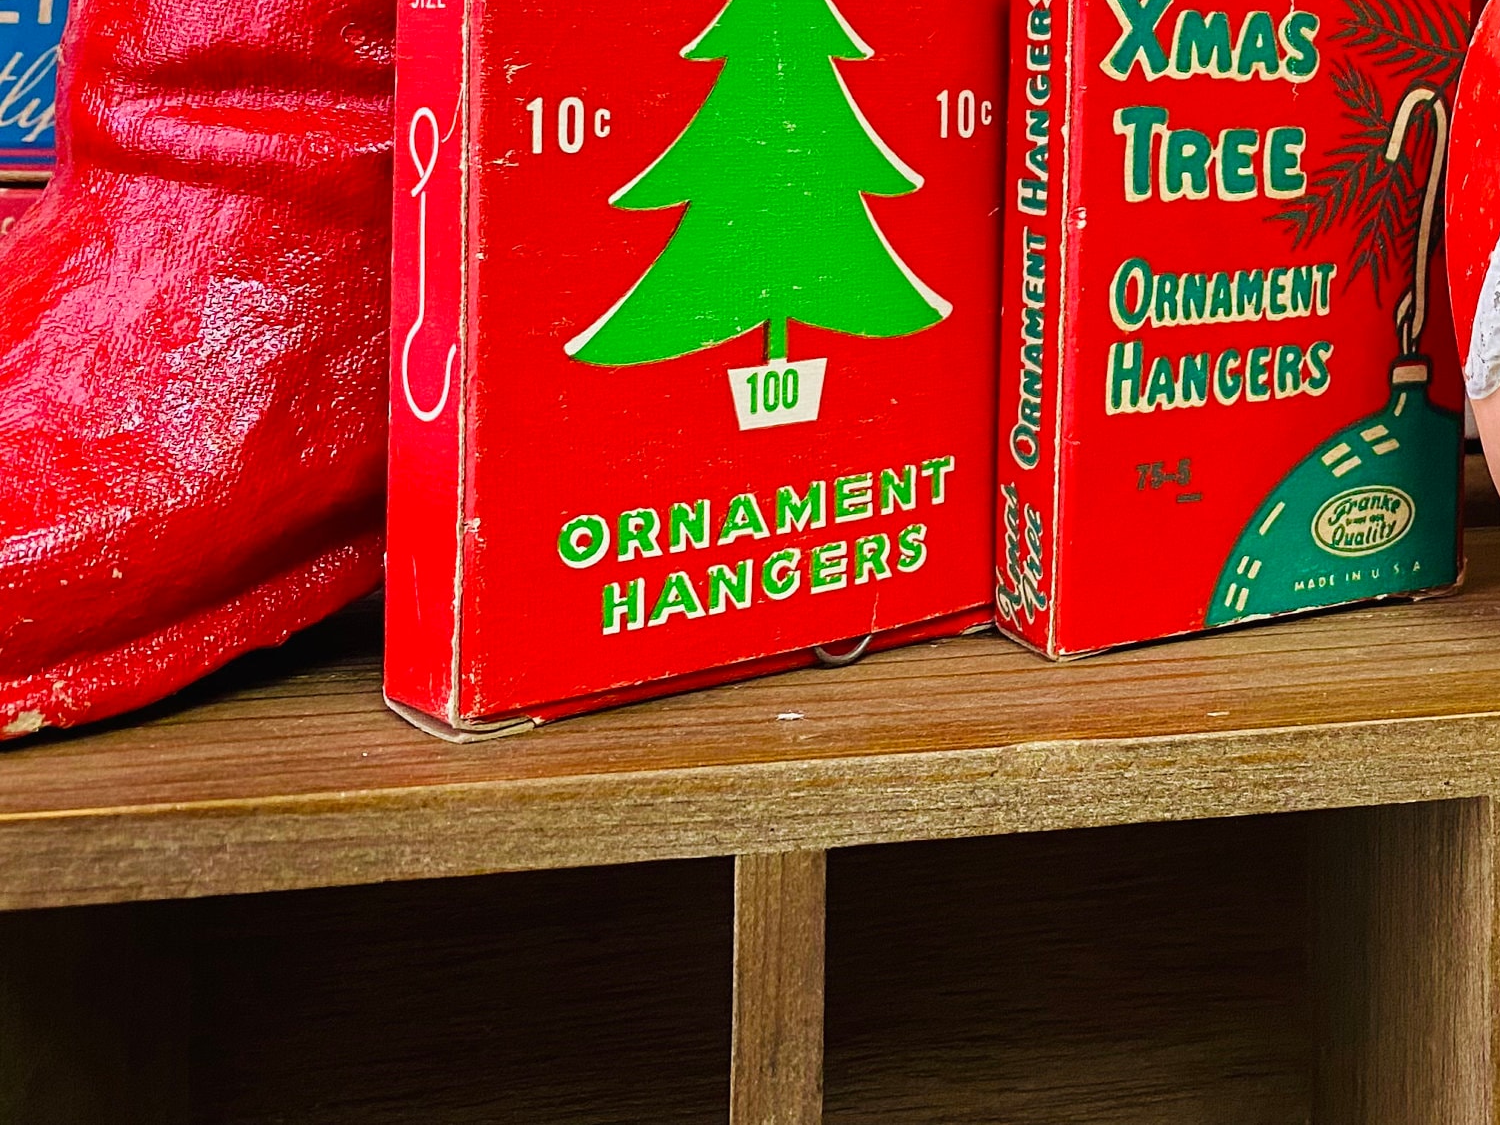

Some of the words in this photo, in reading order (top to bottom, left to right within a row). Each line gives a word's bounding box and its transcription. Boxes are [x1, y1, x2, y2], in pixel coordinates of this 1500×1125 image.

[1113, 105, 1307, 202] TREE
[1109, 258, 1338, 332] ORNAMENT
[1009, 225, 1047, 470] ORNAMENT
[1105, 341, 1334, 416] HANGERS
[746, 368, 800, 415] 100
[557, 454, 956, 570] ORNAMENT
[1328, 494, 1401, 527] Franke
[1332, 520, 1397, 547] Quality
[601, 523, 928, 635] HANGERS
[1295, 574, 1335, 591] MADE
[1345, 570, 1361, 582] IN
